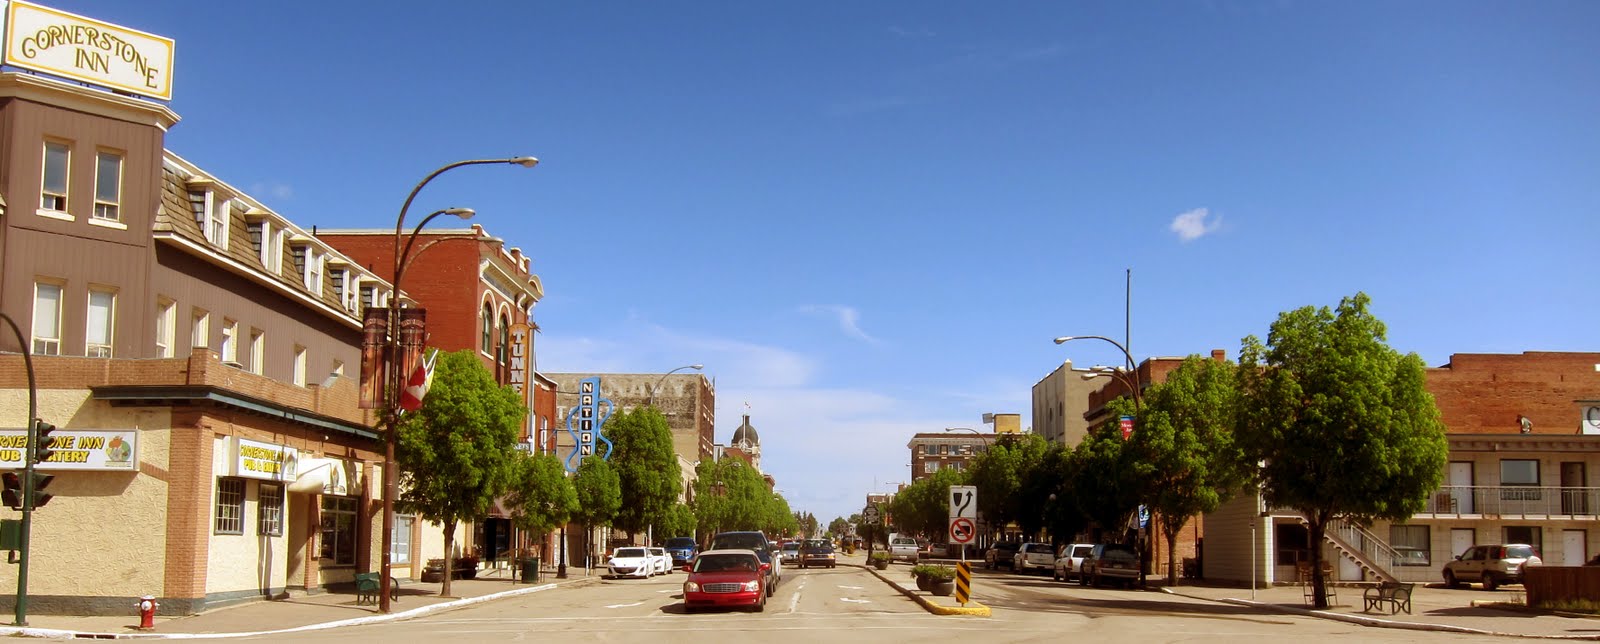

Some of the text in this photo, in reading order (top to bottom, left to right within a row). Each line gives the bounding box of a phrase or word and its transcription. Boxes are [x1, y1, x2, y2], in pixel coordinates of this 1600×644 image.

[22, 25, 159, 89] CORNERSTONE
[75, 47, 110, 75] INN
[78, 437, 105, 450] INN
[48, 451, 90, 463] ATERY
